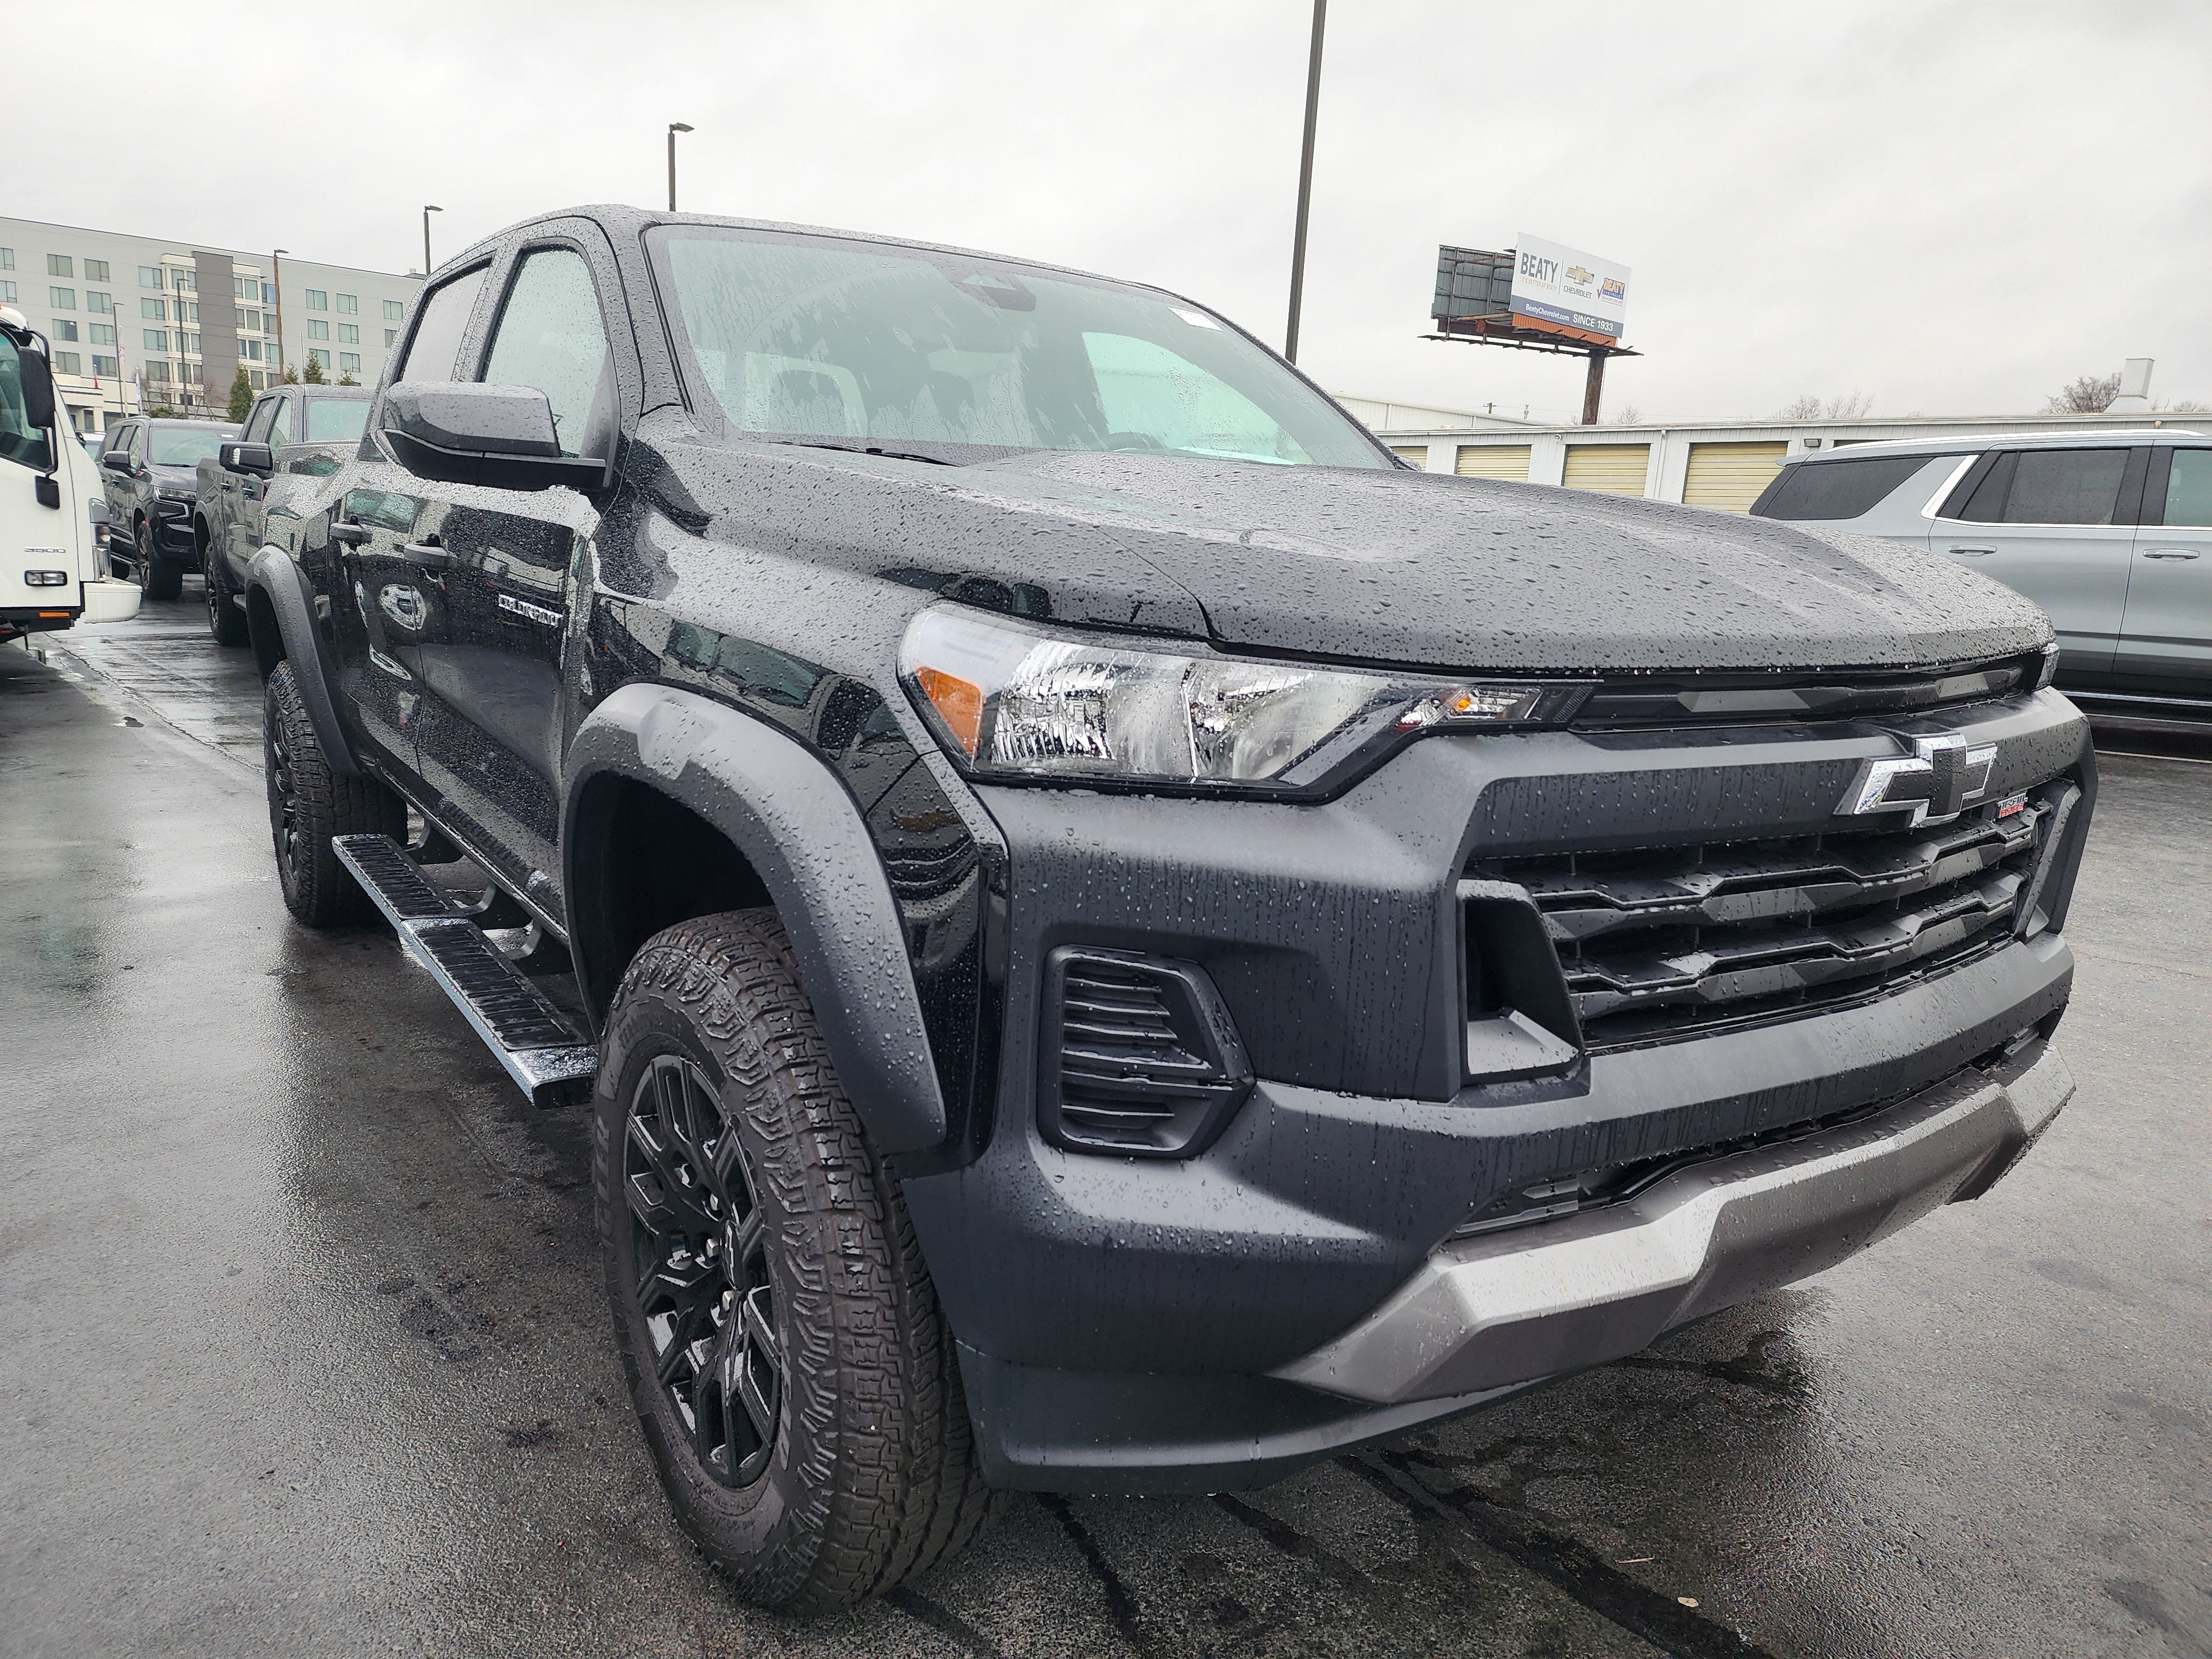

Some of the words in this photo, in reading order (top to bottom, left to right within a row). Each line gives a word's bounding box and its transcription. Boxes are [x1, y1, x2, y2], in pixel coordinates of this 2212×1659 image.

[1520, 252, 1558, 283] BEATY
[1563, 285, 1592, 299] CHEVROLET
[1603, 290, 1623, 299] CHEVROLET
[1604, 278, 1624, 295] BEATY
[1525, 304, 1569, 321] BeatyChevrolet.com
[1573, 314, 1595, 327] SINCE
[1597, 320, 1613, 331] 1933
